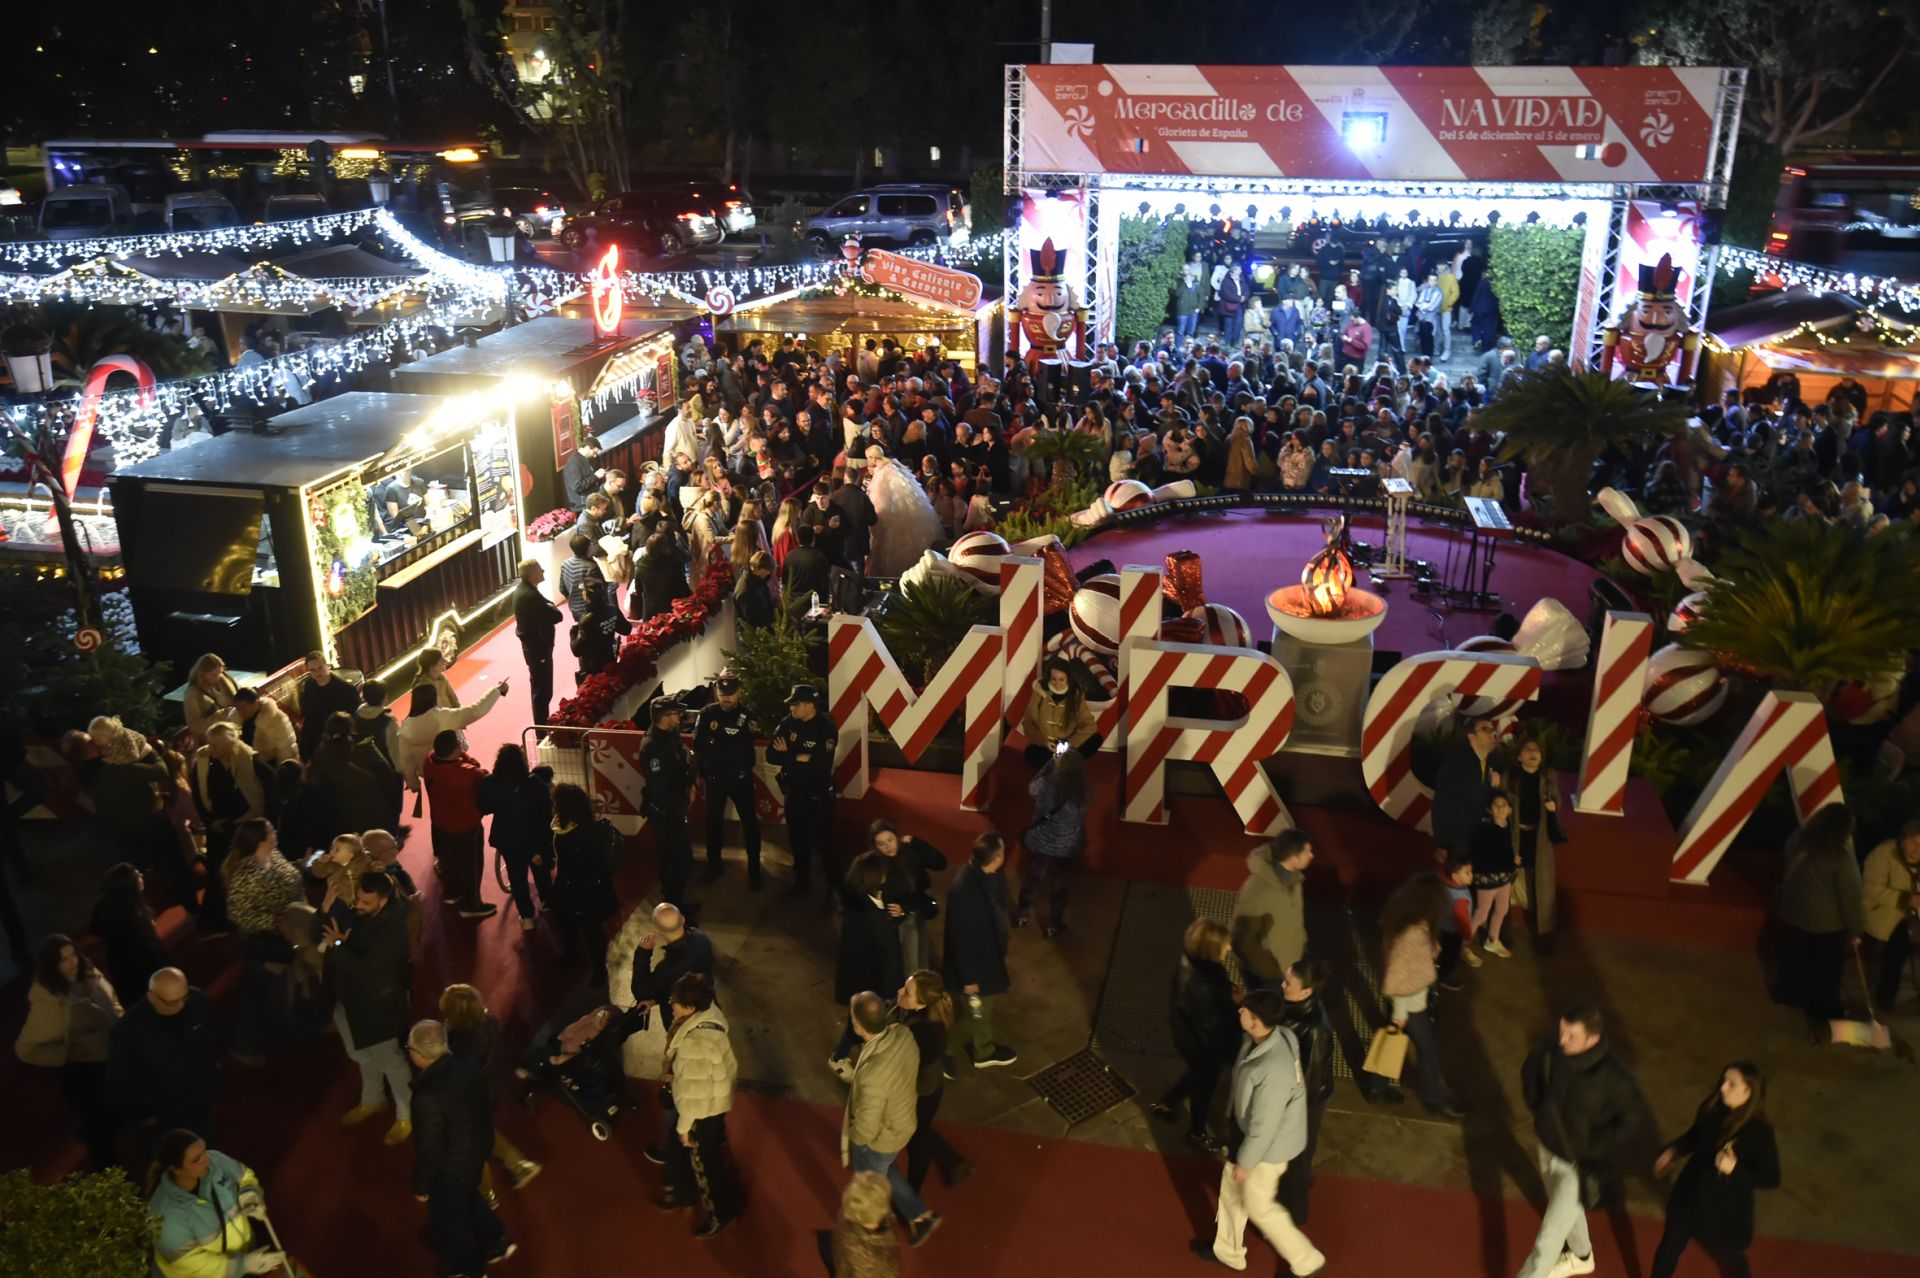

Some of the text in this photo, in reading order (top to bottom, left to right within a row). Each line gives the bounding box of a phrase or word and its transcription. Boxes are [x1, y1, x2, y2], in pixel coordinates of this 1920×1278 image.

[1114, 97, 1303, 122] Mercadillo de
[1440, 98, 1604, 127] NAVIDAD
[1158, 126, 1248, 139] Glorieta de España
[1439, 130, 1601, 141] Del 5 de diciembre al 5 de enero
[882, 260, 963, 291] Vino Caliente
[902, 276, 951, 298] Cerveza
